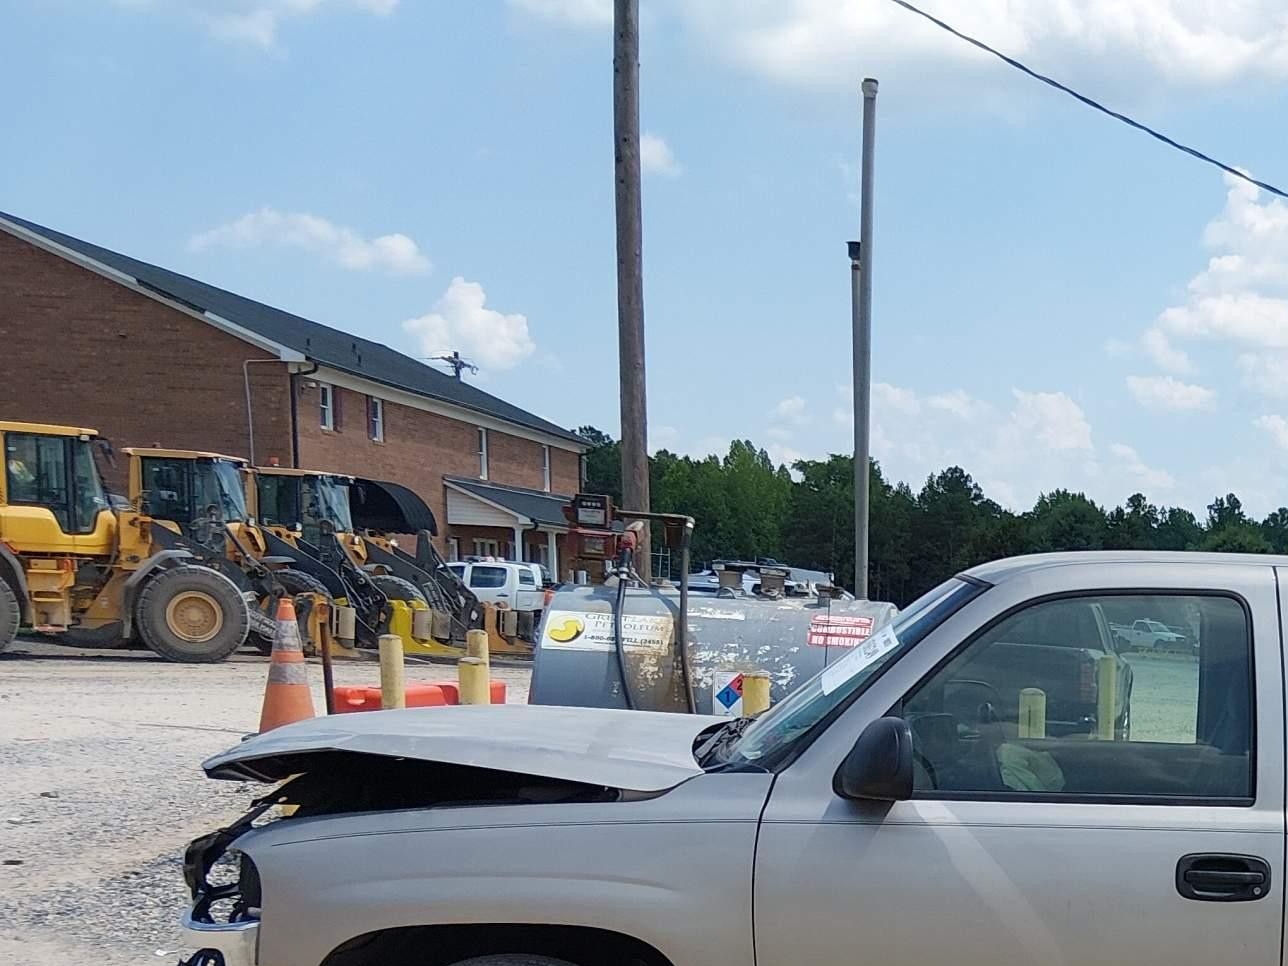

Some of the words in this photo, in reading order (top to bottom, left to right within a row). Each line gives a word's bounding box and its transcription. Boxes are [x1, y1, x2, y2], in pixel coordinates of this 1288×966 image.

[595, 620, 664, 632] PETOLEUM
[811, 635, 824, 645] NO
[737, 679, 743, 690] 2
[725, 690, 730, 703] 1
